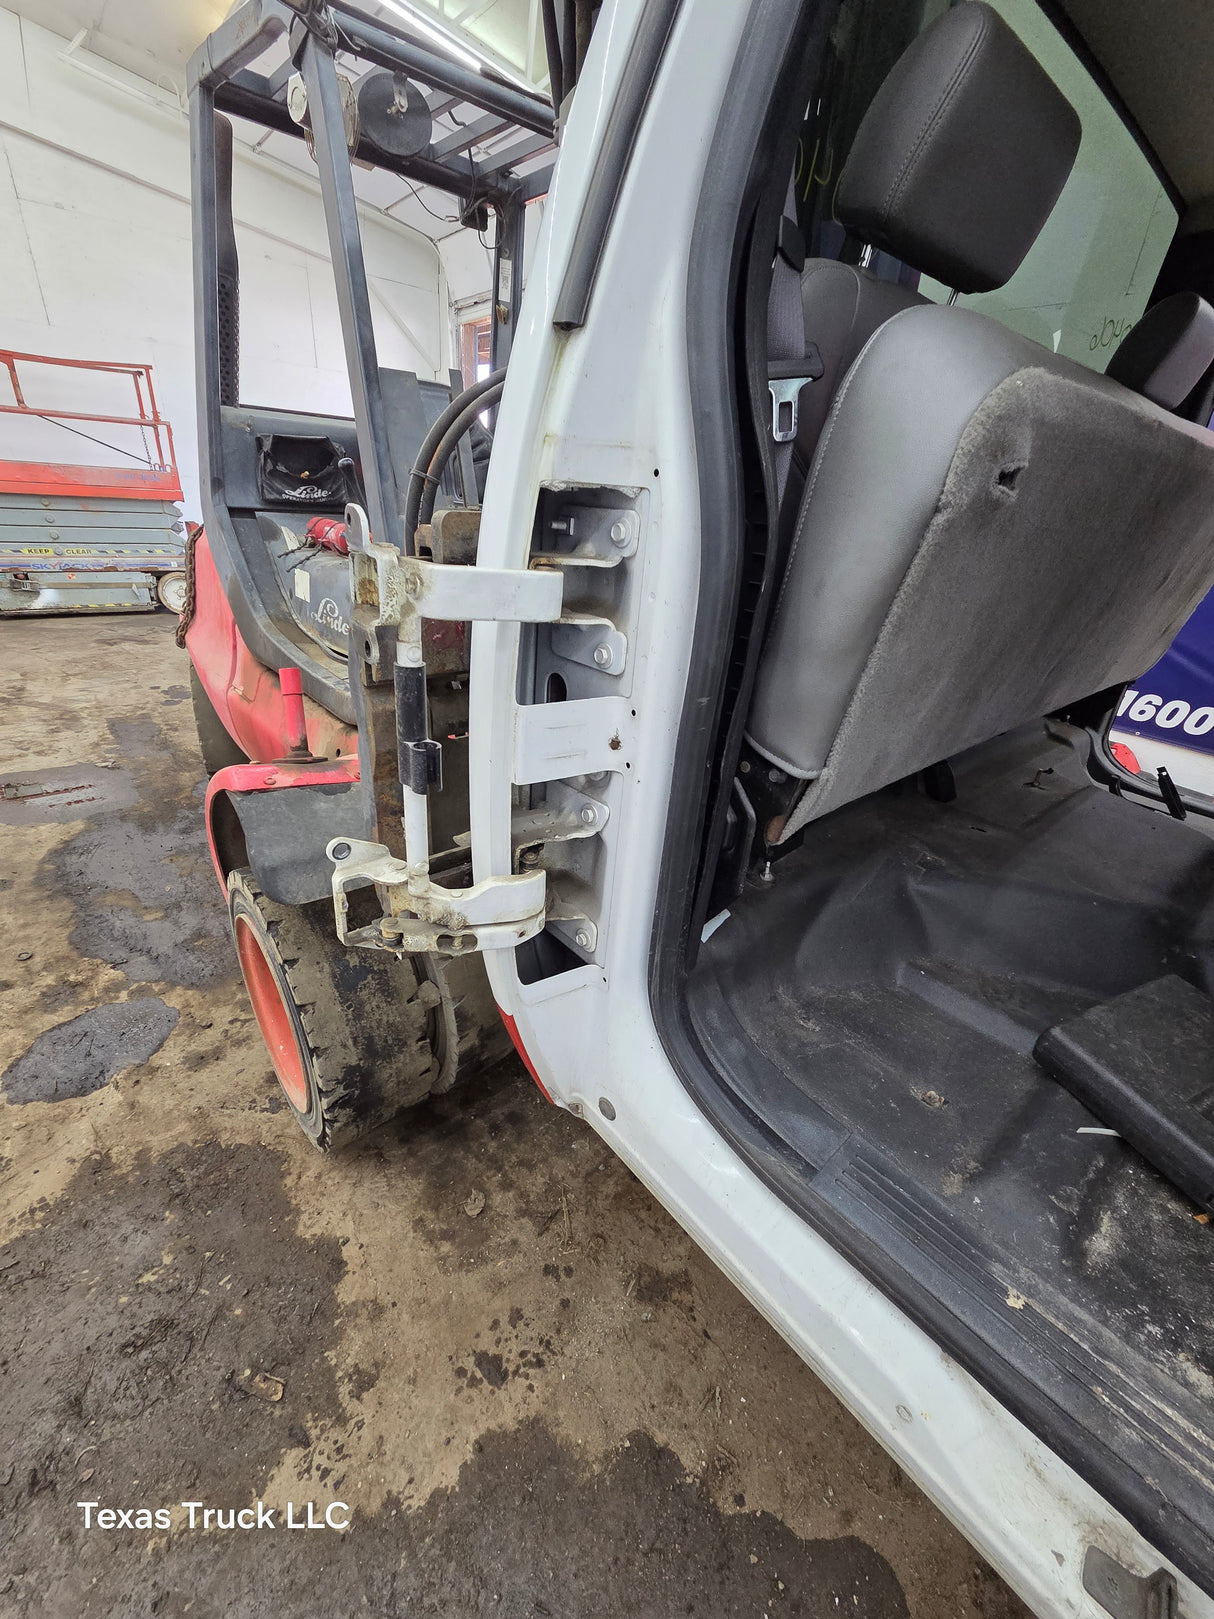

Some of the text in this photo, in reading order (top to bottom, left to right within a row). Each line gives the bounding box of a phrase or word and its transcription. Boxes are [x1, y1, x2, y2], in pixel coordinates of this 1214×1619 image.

[284, 485, 329, 499] Linde
[31, 561, 90, 571] SKYJACK
[310, 597, 350, 636] Linde
